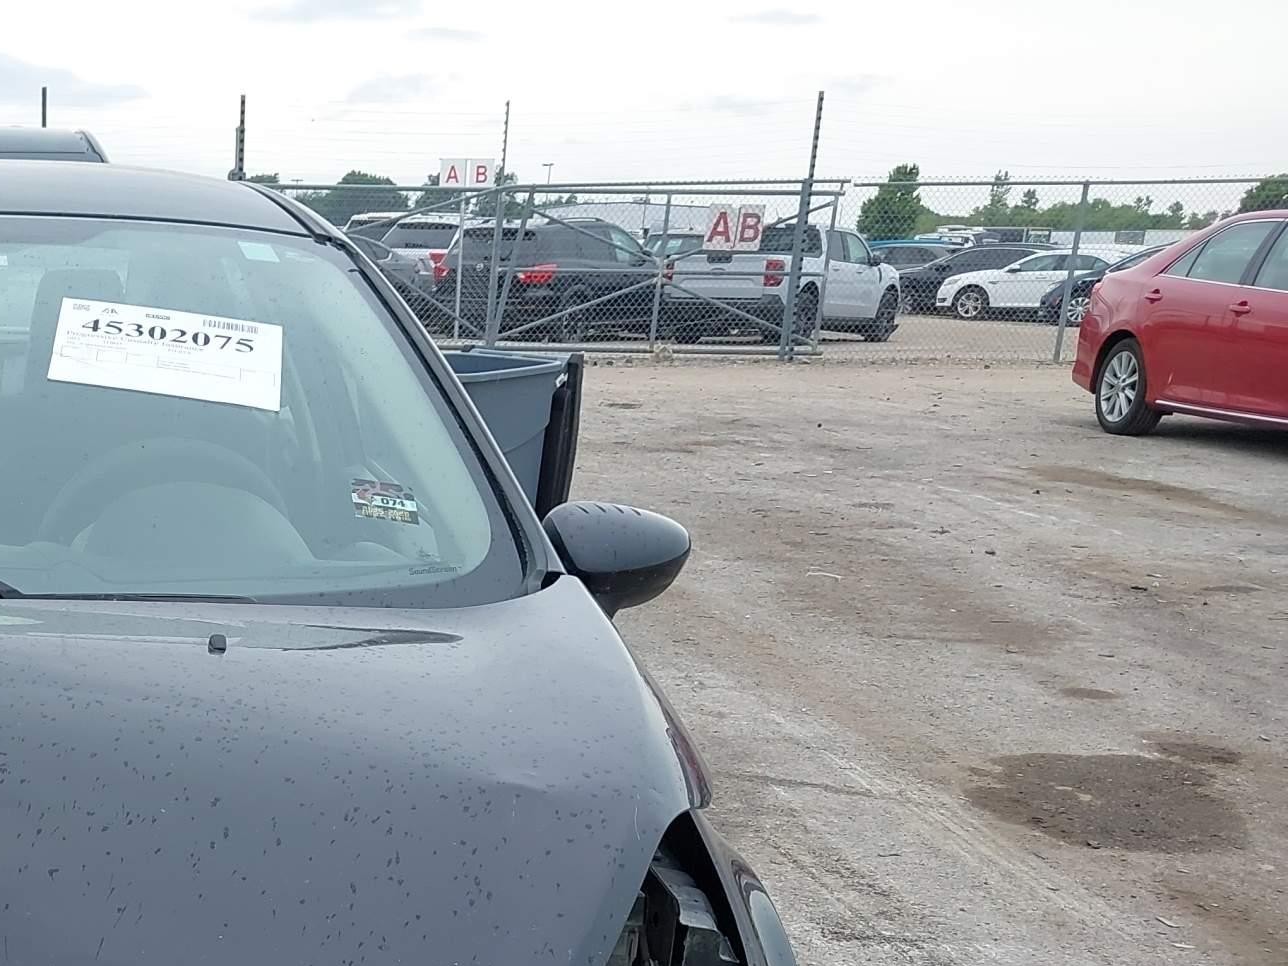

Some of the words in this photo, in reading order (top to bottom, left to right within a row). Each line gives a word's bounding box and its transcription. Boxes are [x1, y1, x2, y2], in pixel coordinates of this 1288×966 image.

[445, 165, 459, 184] A
[475, 165, 488, 184] B
[706, 211, 731, 243] A
[739, 212, 761, 243] B
[81, 318, 255, 354] 45302075
